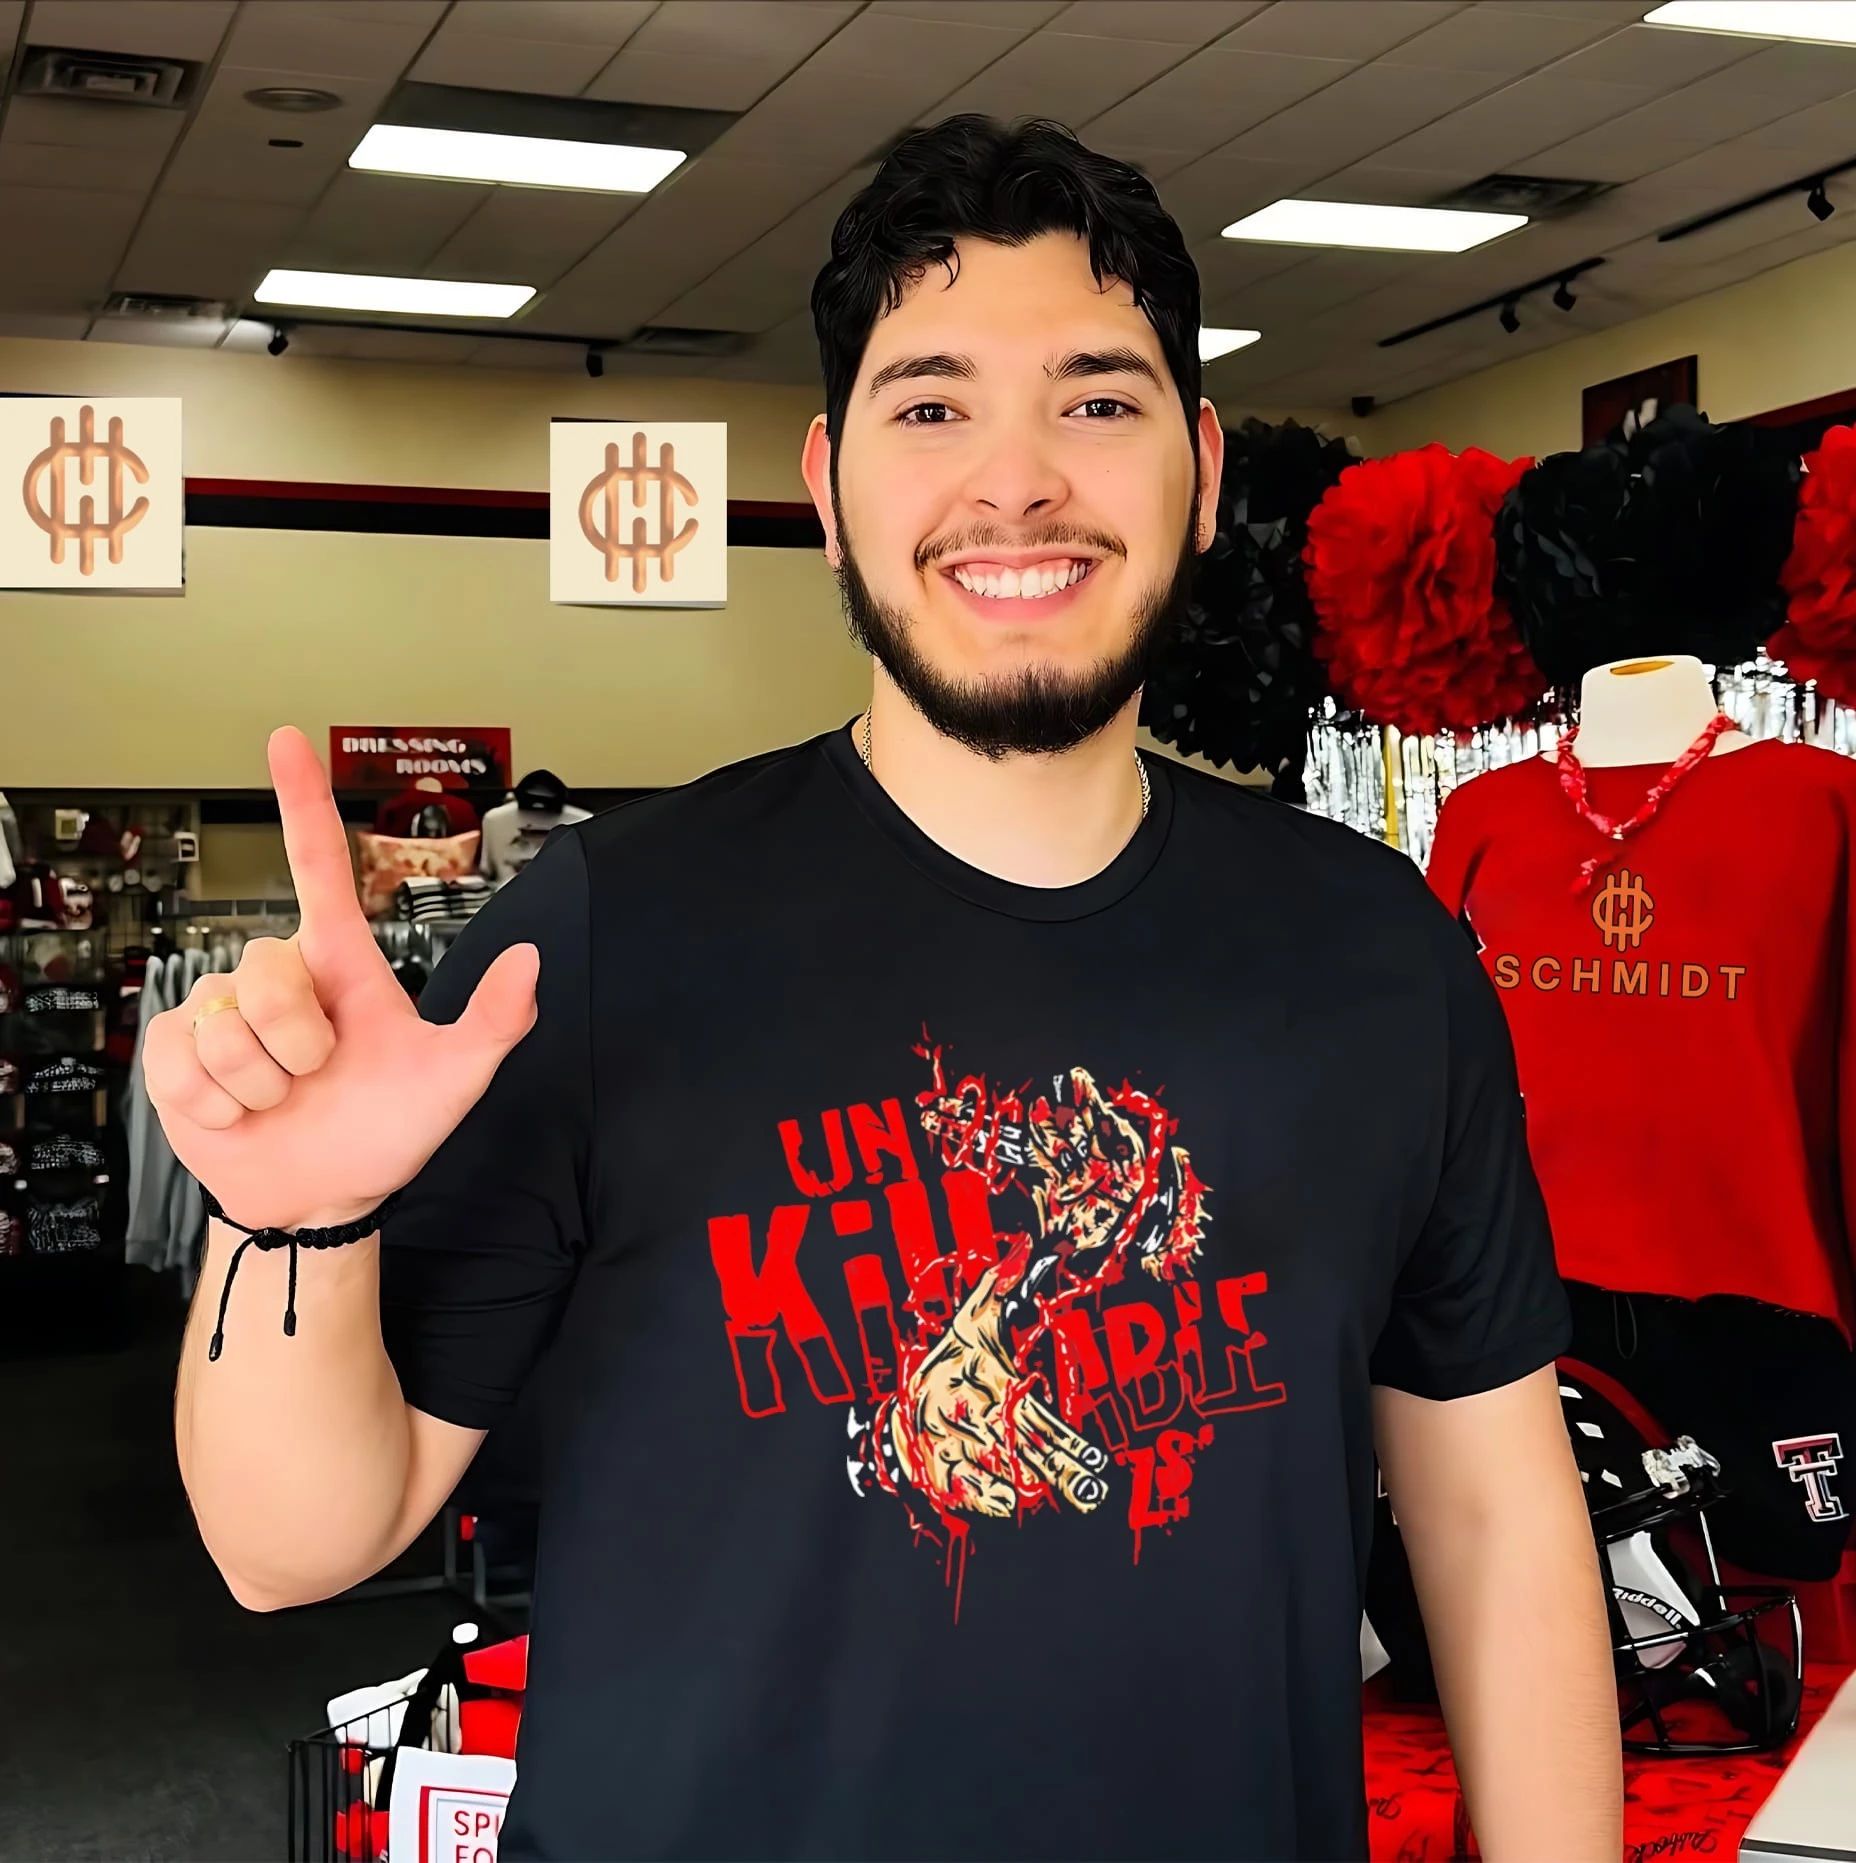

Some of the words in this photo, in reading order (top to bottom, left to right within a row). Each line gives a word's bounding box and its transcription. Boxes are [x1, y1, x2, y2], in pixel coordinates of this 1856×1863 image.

[342, 737, 466, 754] DRESSING
[396, 758, 487, 775] ROOMS
[1494, 953, 1747, 1000] SCHMIDT
[777, 1097, 920, 1198] UN
